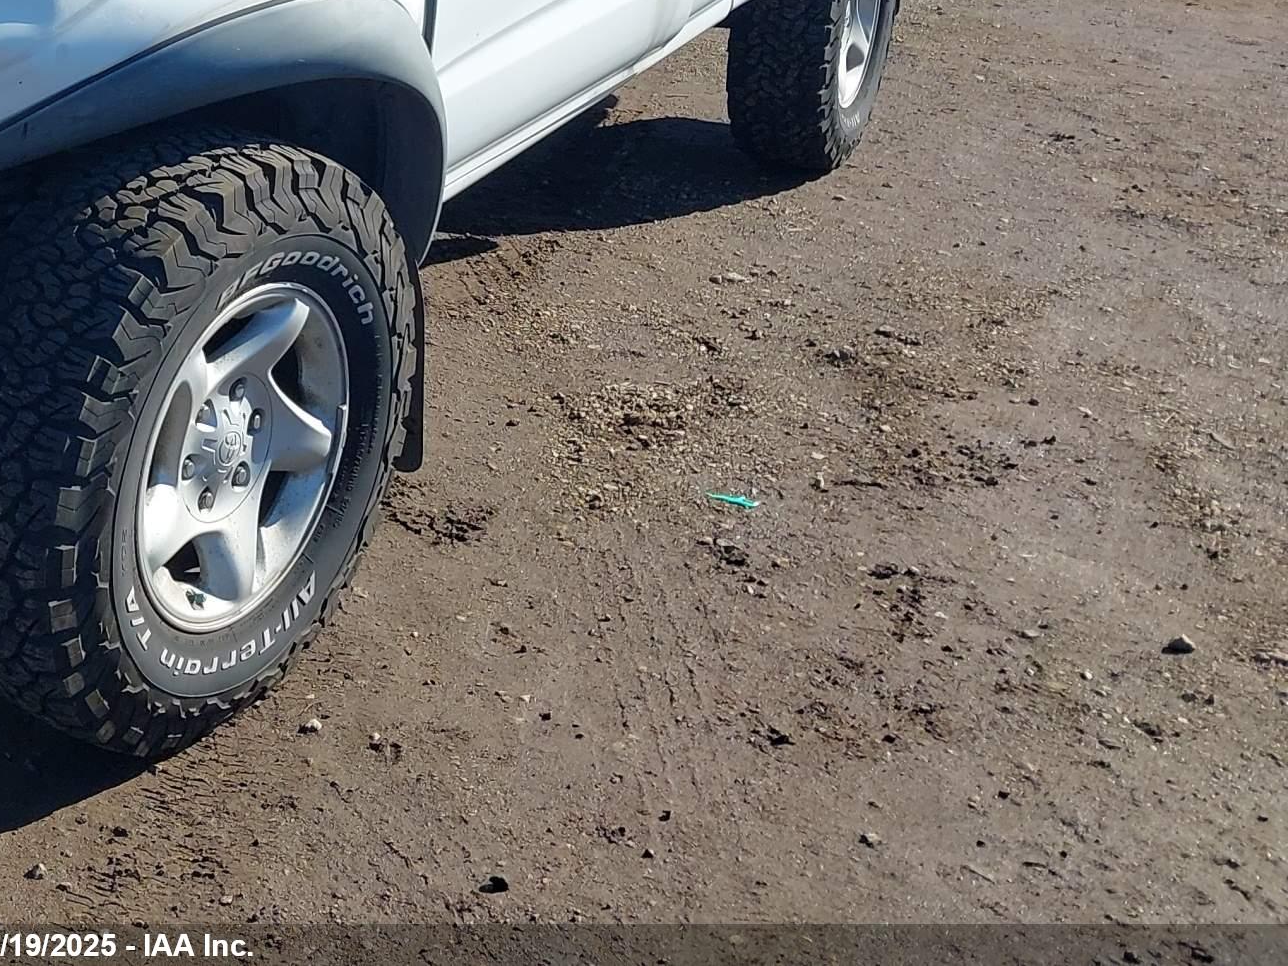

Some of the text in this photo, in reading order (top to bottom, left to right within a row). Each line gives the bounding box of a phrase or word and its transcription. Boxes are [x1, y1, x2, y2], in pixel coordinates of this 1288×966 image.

[216, 251, 374, 325] BFGoodrich
[125, 585, 152, 651] T/A
[160, 570, 316, 676] All-Terrain
